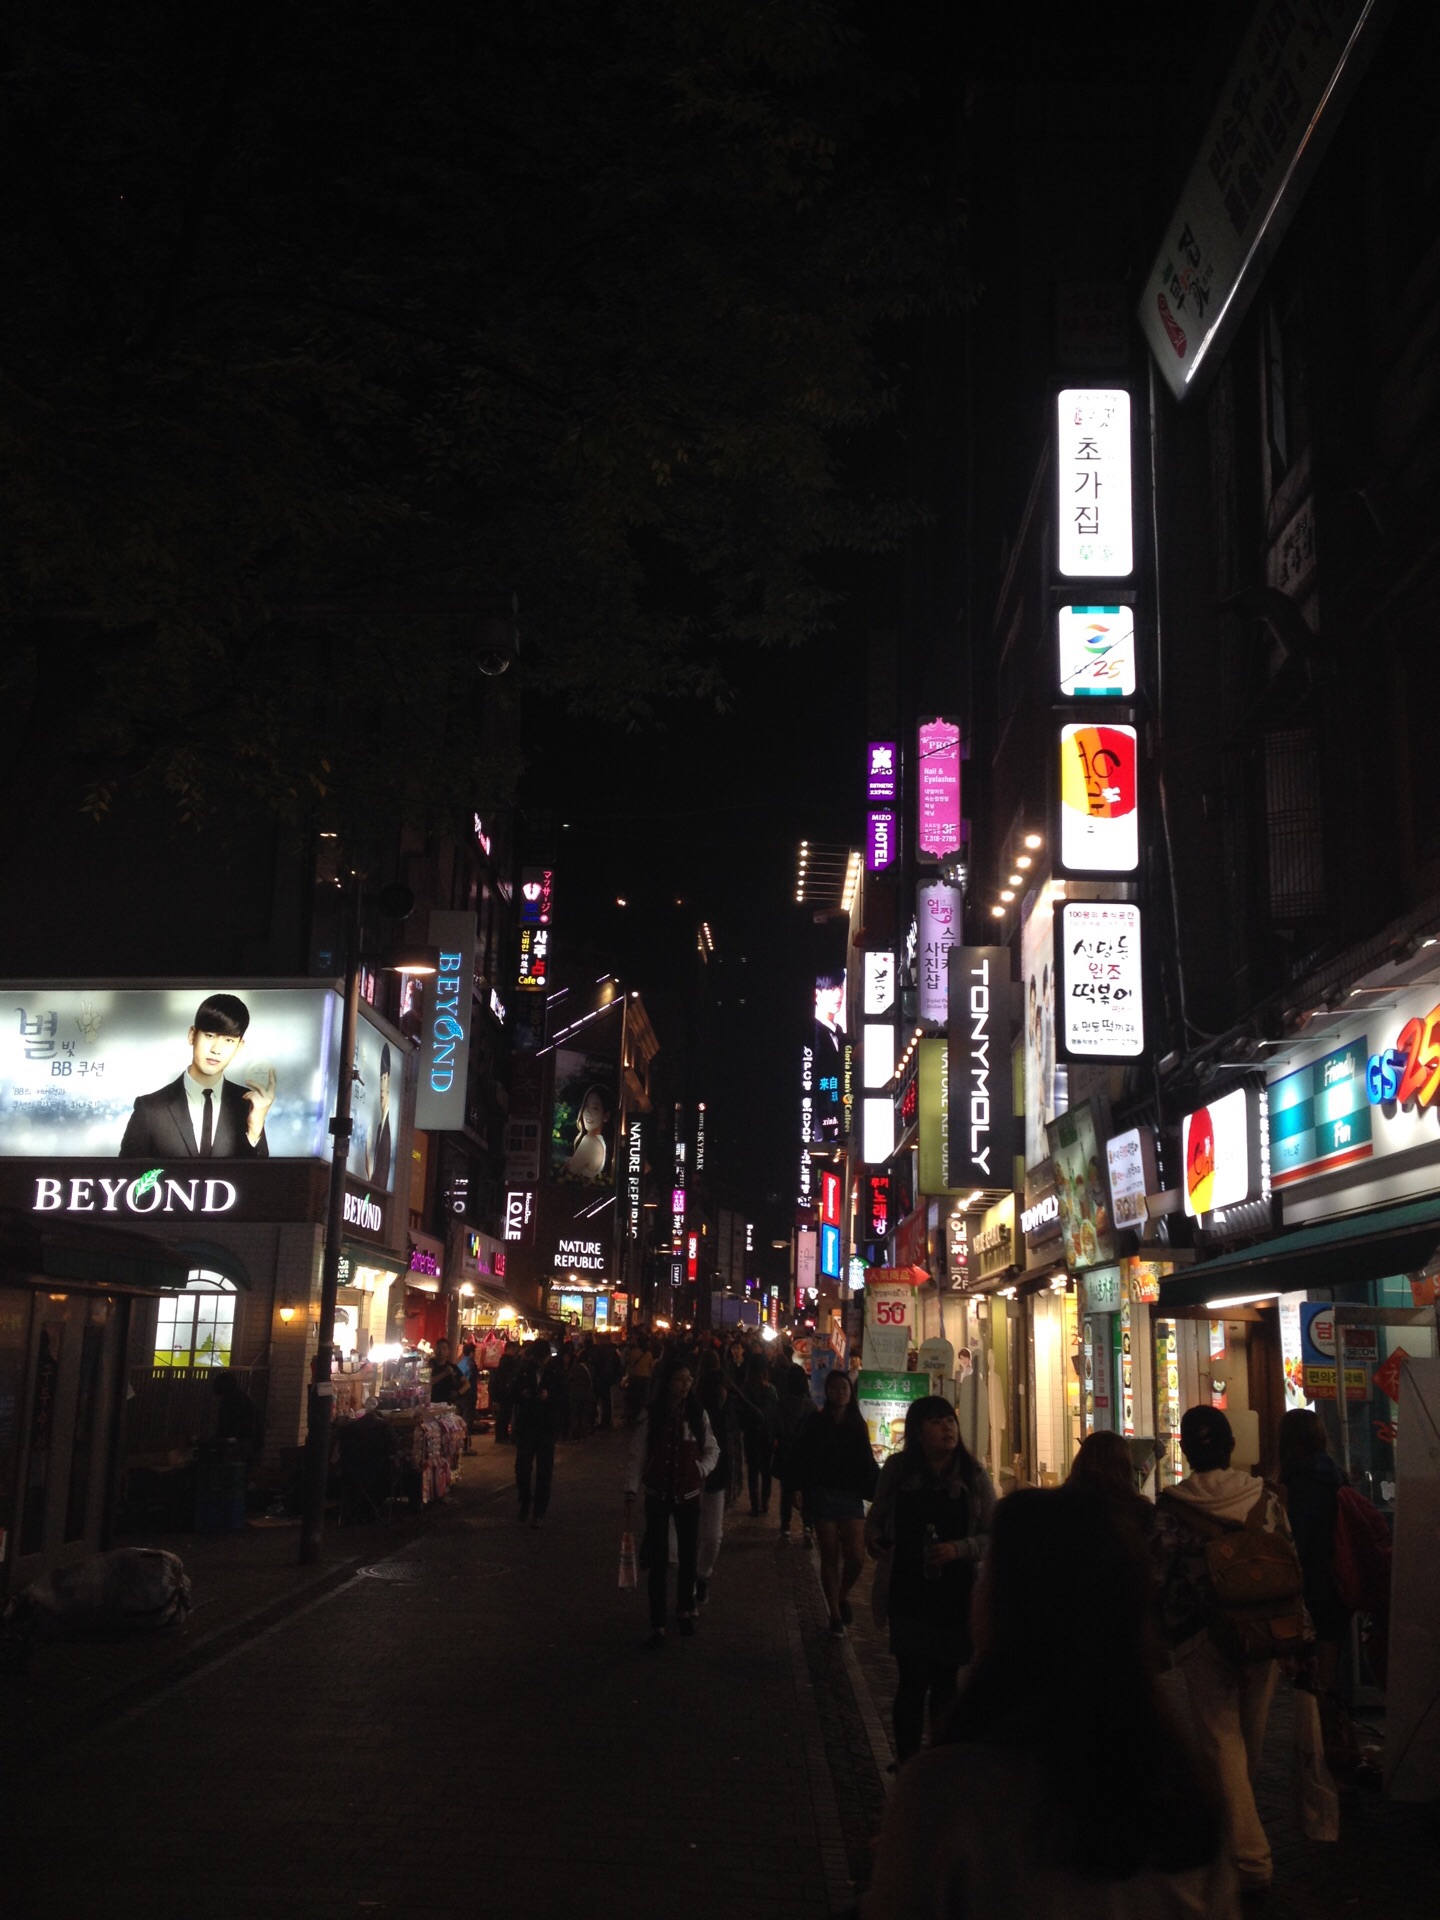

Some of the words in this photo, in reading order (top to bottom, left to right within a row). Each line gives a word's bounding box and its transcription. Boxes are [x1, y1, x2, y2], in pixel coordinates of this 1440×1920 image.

[1074, 437, 1103, 536] 초가집
[929, 741, 951, 750] PRO
[924, 776, 956, 784] Eyelashes
[942, 823, 957, 834] 3F
[874, 822, 889, 867] HOTEL
[541, 871, 552, 912] マッサージ
[927, 899, 954, 924] 얼짱
[1073, 936, 1129, 960] 신당동
[925, 942, 940, 989] 사진샵
[1089, 962, 1122, 980] 원조
[518, 976, 536, 985] Cafe
[1072, 983, 1132, 1005] 떡볶이
[430, 951, 463, 1093] BEYOND
[51, 1060, 73, 1077] BB
[77, 1060, 105, 1077] 쿠션
[844, 1045, 853, 1070] Gloria
[970, 958, 990, 1176] TONYMOLY
[1366, 1004, 1440, 1108] GS25
[1323, 1052, 1356, 1087] Friendly
[628, 1121, 642, 1173] NATURE
[1333, 1120, 1351, 1148] Fun
[696, 1131, 706, 1171] SKYPARK
[32, 1177, 237, 1214] BEYOND
[342, 1192, 382, 1231] BEYOND
[505, 1191, 524, 1240] LOVE
[873, 1189, 887, 1235] 노래방
[559, 1239, 602, 1255] NATURE
[951, 1220, 969, 1266] 얼짱
[554, 1254, 605, 1270] REPUBLIC
[951, 1274, 969, 1290] 2F
[584, 1303, 593, 1312] 50
[877, 1301, 905, 1325] 50
[874, 1378, 911, 1393] 초가집
